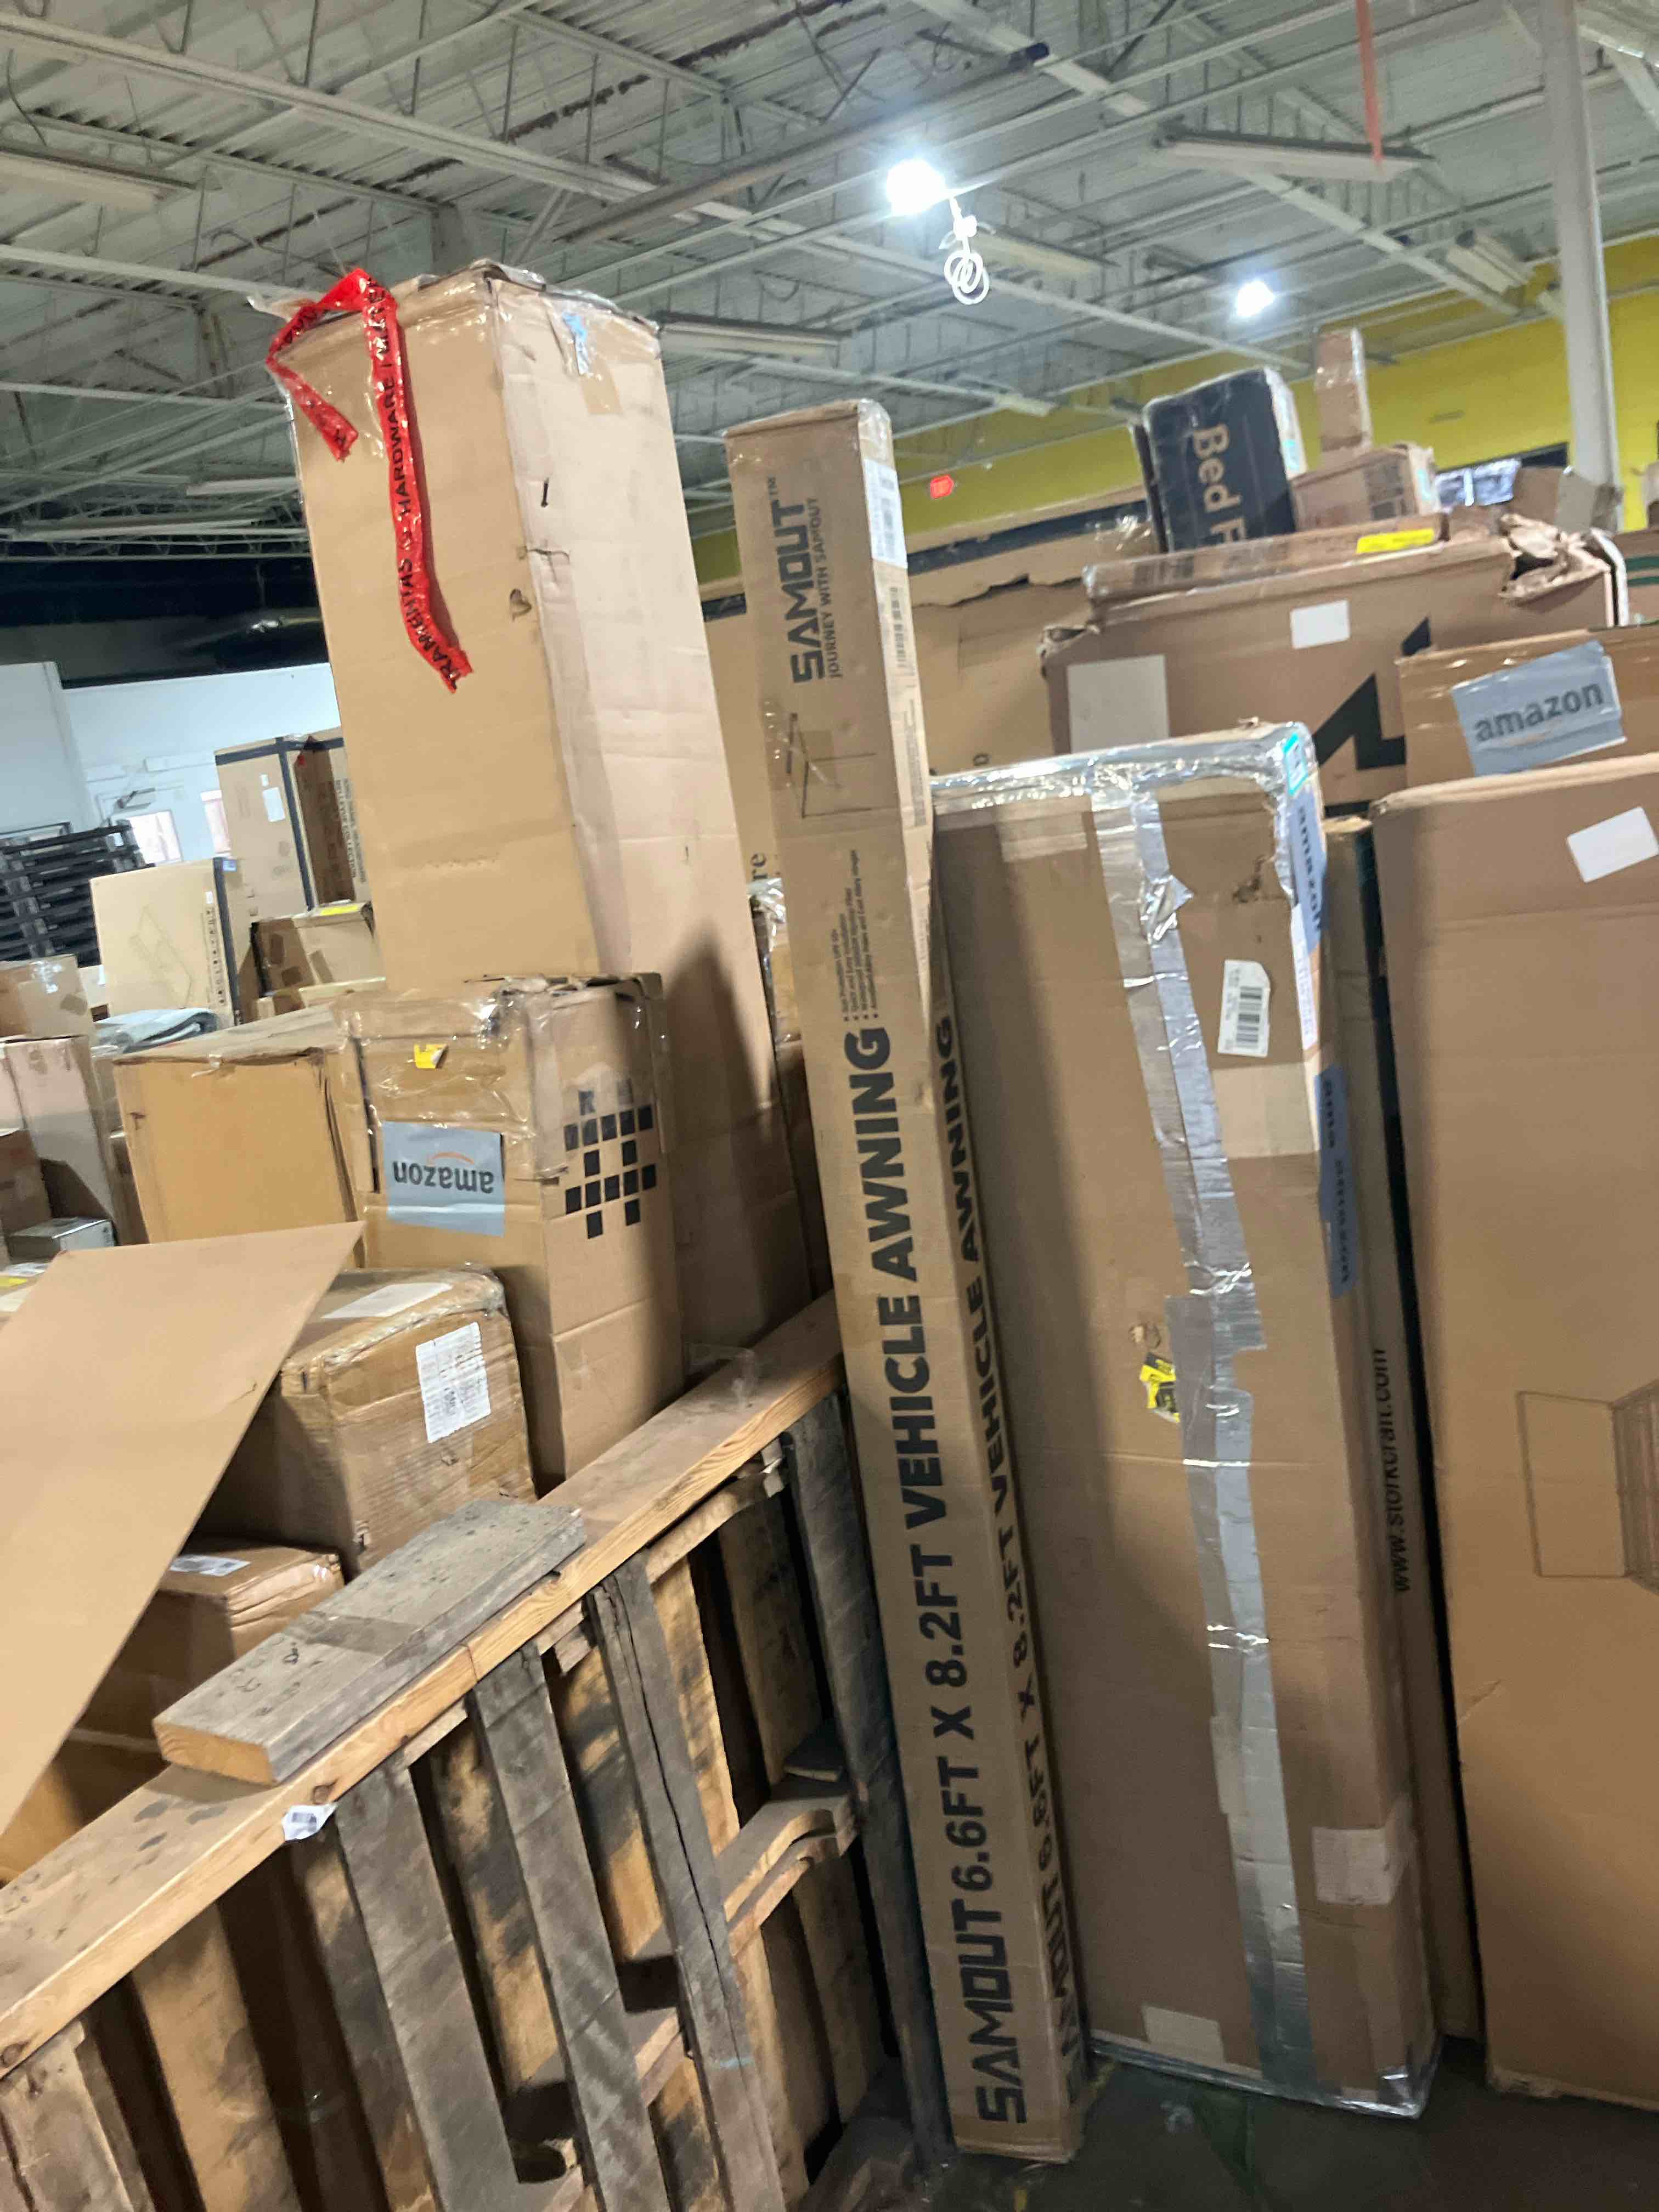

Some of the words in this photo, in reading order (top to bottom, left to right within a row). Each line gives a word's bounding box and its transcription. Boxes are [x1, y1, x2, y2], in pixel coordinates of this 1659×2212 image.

[383, 377, 411, 516] HARDWARE
[1193, 422, 1242, 513] Bed
[770, 500, 826, 684] SAMOUT
[806, 496, 827, 566] SAMOUT
[816, 567, 832, 606] WITH
[821, 612, 843, 679] JOURNEY
[1474, 684, 1605, 742] amazon
[392, 1160, 494, 1194] amazon
[844, 1027, 918, 1282] AWNING
[936, 1016, 979, 1262] AWNING
[877, 1295, 947, 1530] VEHICLE
[966, 1276, 1008, 1514] VEHICLE
[909, 1543, 968, 1688] 8.2FT
[929, 1705, 974, 1740] X
[937, 1756, 993, 1892] 6.6FT
[950, 1898, 1028, 2124] SAMOUT
